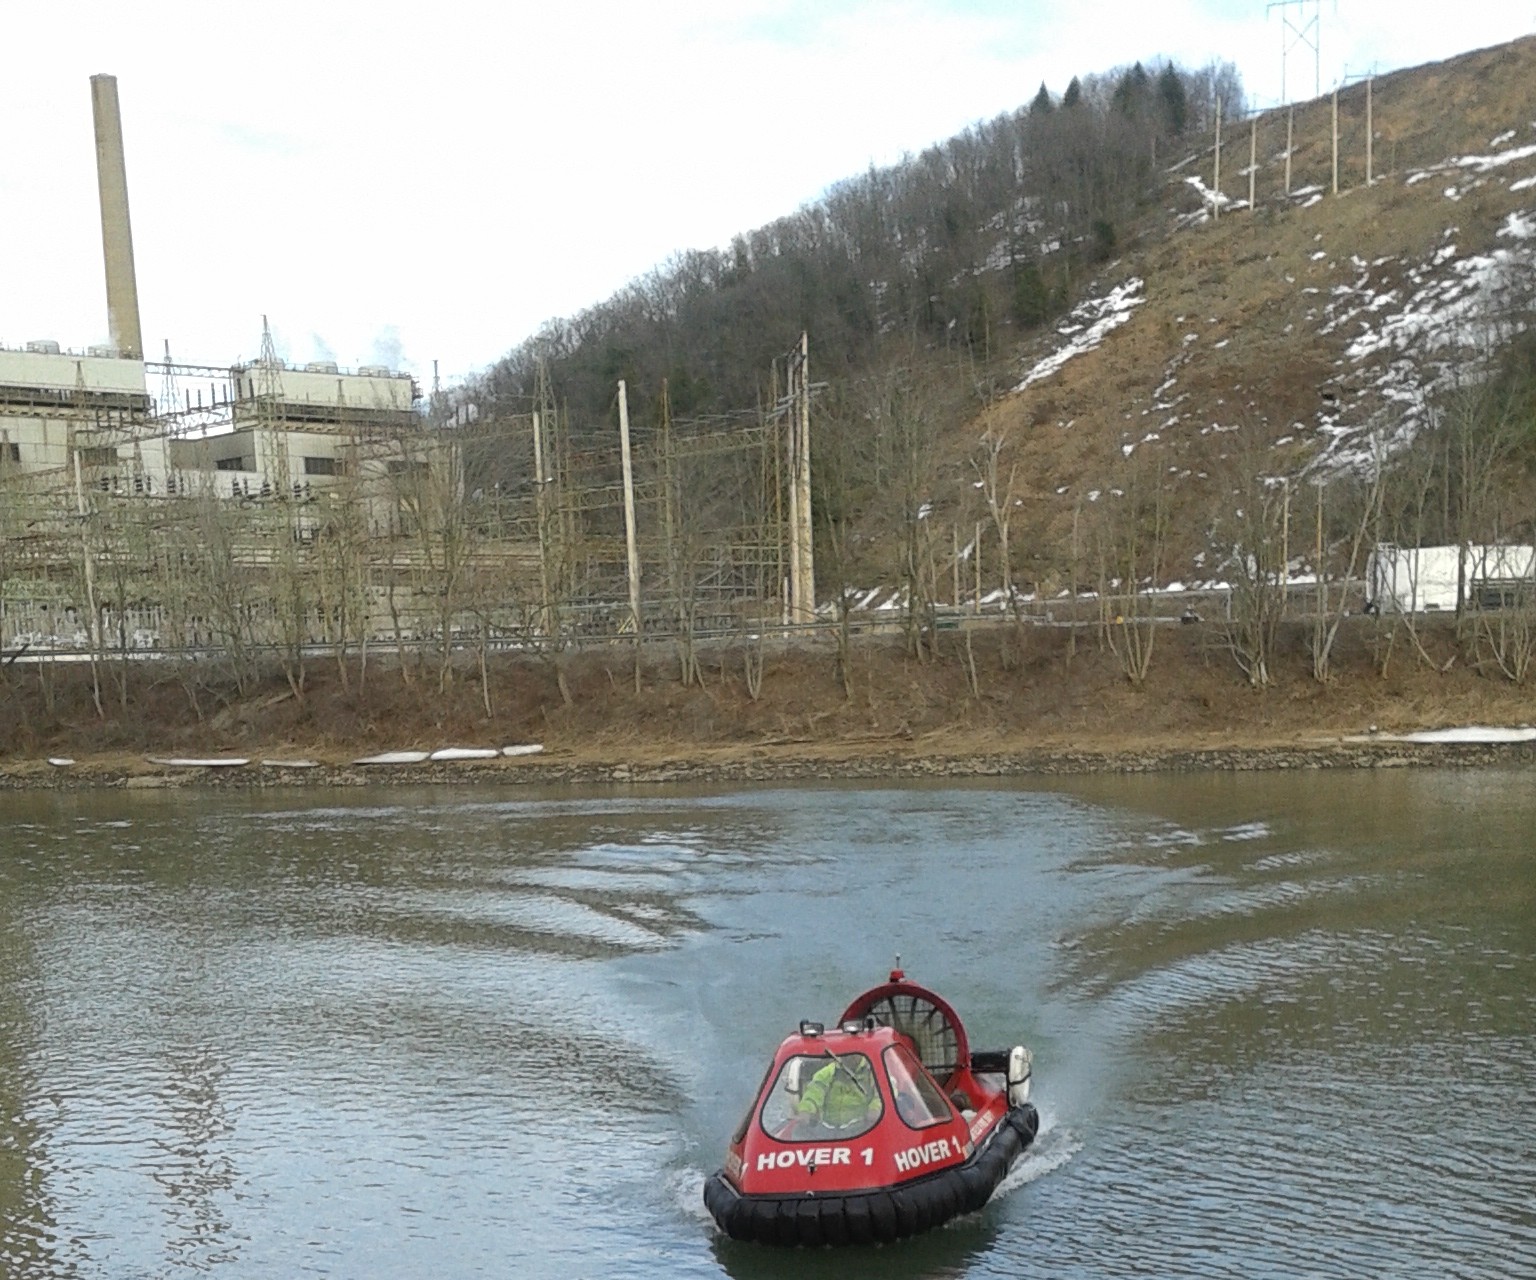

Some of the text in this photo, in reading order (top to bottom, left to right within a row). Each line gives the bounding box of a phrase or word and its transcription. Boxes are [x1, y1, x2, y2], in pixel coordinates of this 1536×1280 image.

[757, 1148, 874, 1171] HOVER 1
[894, 1136, 962, 1172] HOVER 1
